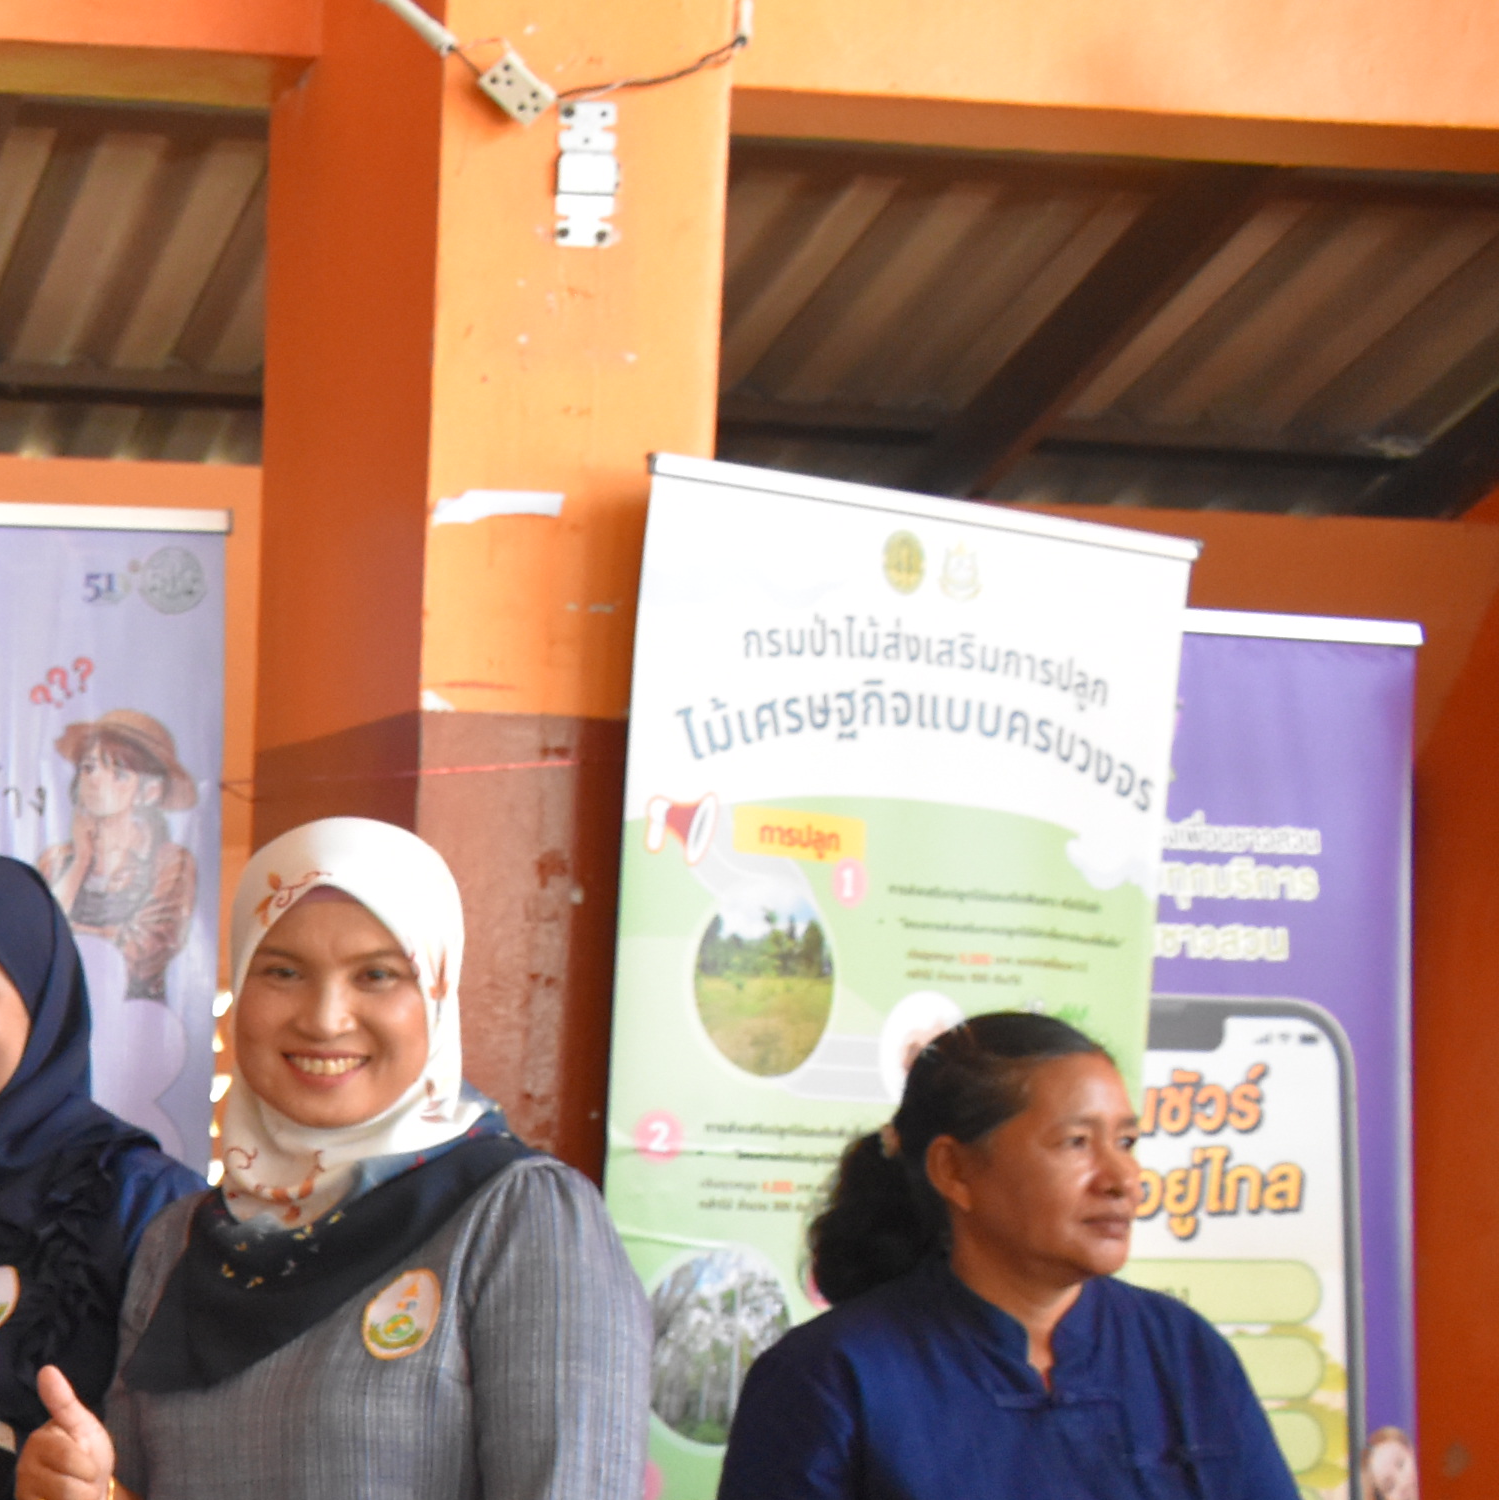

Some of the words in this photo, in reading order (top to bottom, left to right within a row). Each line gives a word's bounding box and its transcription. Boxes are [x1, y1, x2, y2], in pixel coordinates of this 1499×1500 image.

[743, 613, 1109, 712] กรมป่าไม้ส่งเสริมการปลูก
[676, 679, 1156, 813] ไม้เศรษฐกิจแบบครบวงจร
[759, 822, 841, 859] การปลูก
[839, 868, 855, 898] 1
[648, 1121, 670, 1151] 2
